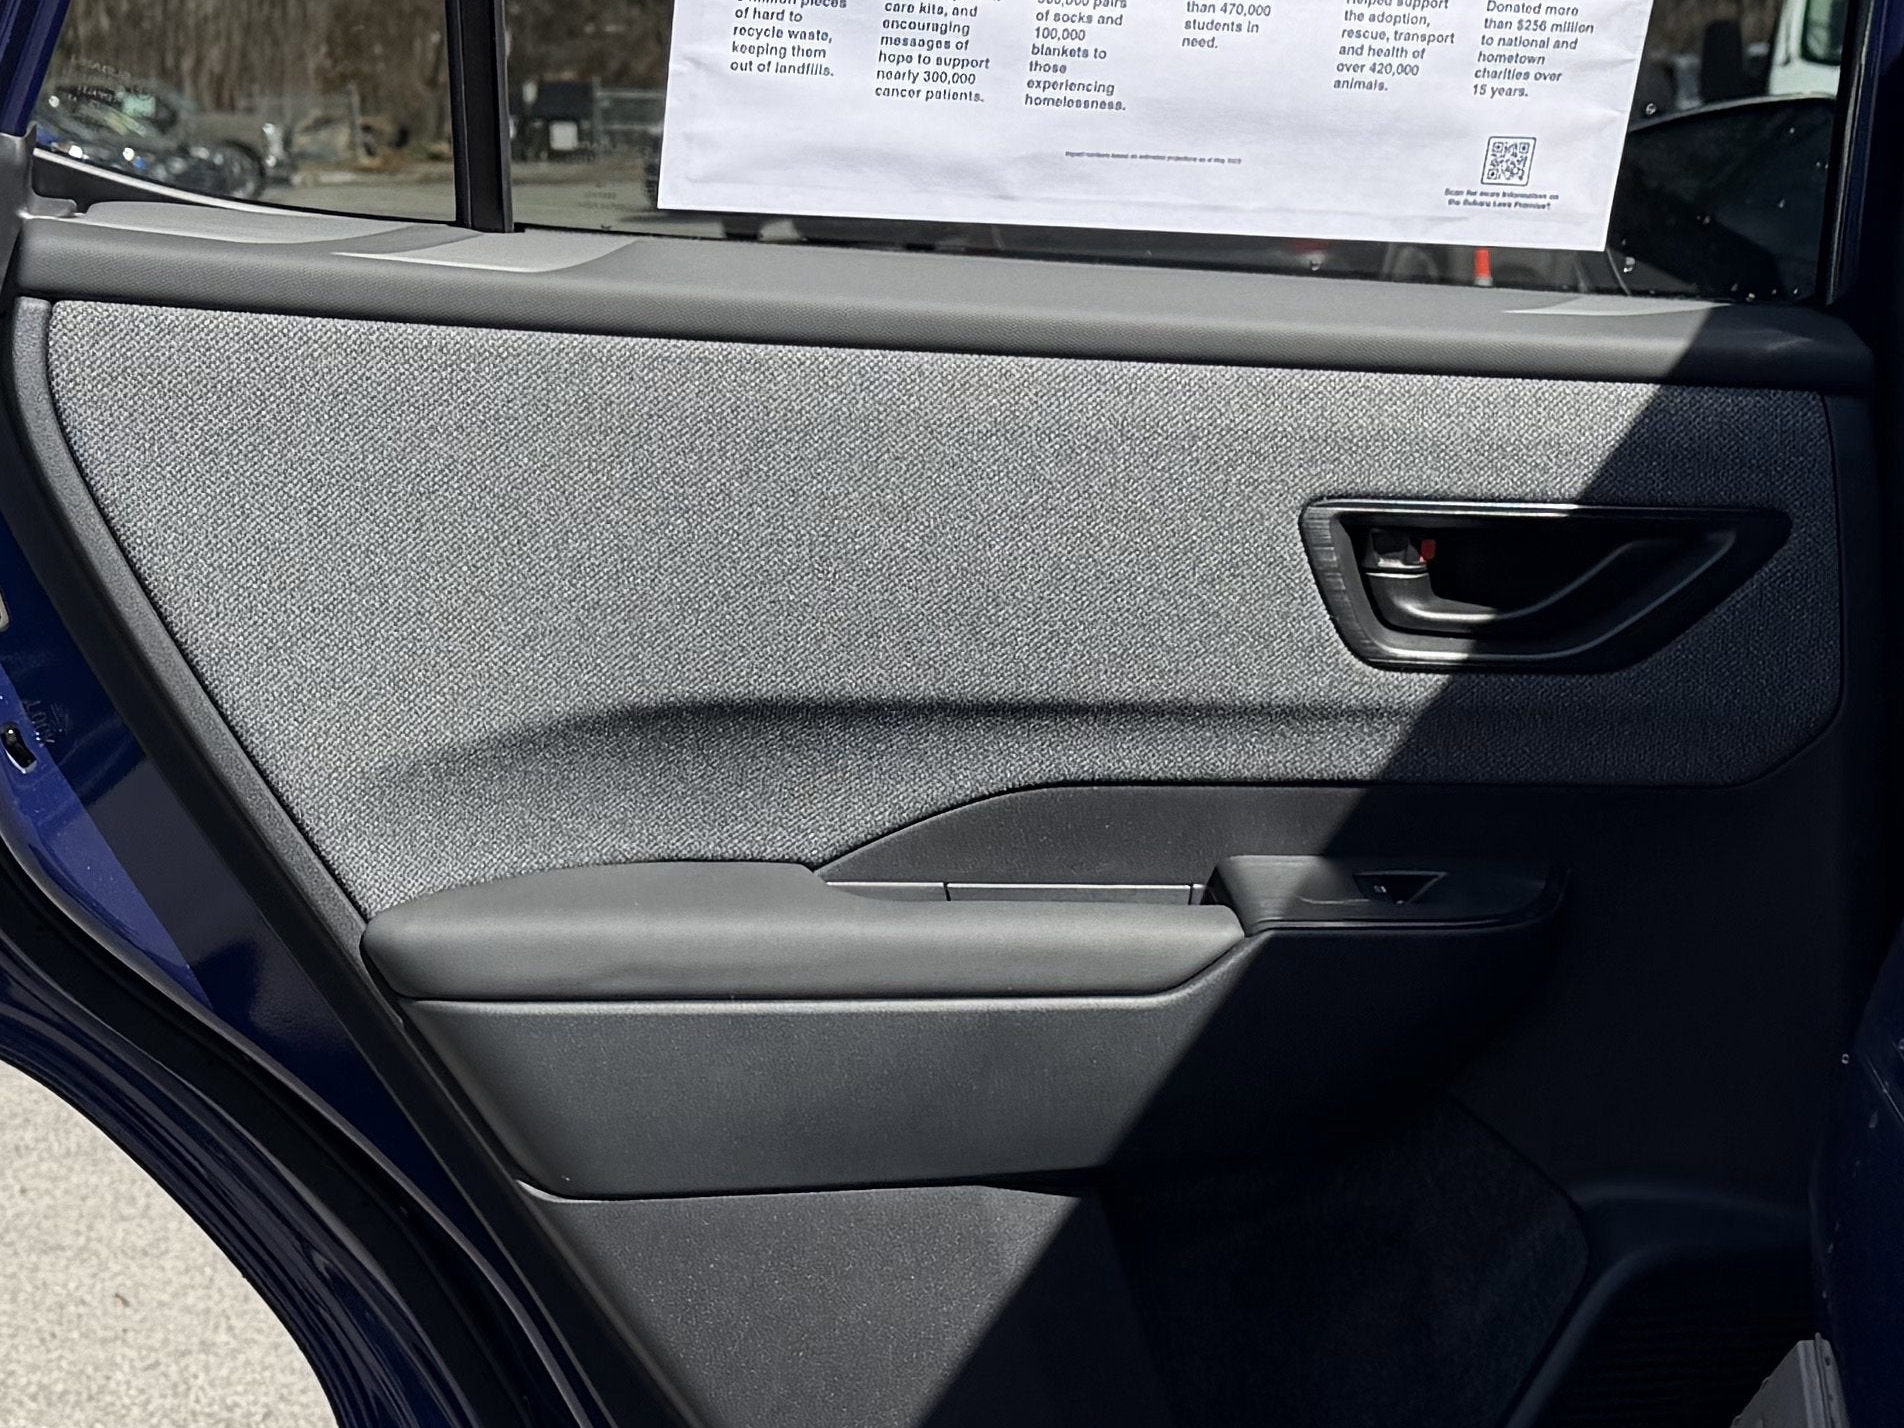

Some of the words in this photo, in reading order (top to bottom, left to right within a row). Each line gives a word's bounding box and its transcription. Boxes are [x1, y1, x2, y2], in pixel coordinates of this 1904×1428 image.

[734, 6, 750, 20] of
[752, 6, 786, 22] hard
[788, 10, 804, 23] to
[884, 2, 915, 14] care
[918, 1, 949, 18] kits,
[951, 5, 978, 18] and
[1186, 0, 1216, 14] than
[1219, 2, 1272, 18] 470,000
[1486, 0, 1543, 15] Donated
[1544, 5, 1579, 17] more
[1035, 8, 1051, 22] of
[1052, 11, 1094, 25] socks
[1097, 13, 1124, 27] and
[1184, 18, 1243, 33] students
[1246, 20, 1260, 34] in
[1344, 8, 1365, 22] the
[1367, 11, 1431, 29] adoption,
[1483, 17, 1513, 30] than
[1516, 18, 1548, 32] $256
[1549, 20, 1595, 35] million
[732, 25, 784, 41] recycle
[787, 29, 833, 44] waste,
[882, 18, 971, 38] encouraging
[1035, 26, 1087, 42] 100,000
[880, 35, 951, 52] messages
[954, 39, 970, 52] of
[1181, 35, 1219, 49] need.
[1341, 28, 1390, 44] rescue,
[1393, 29, 1455, 47] transport
[1480, 34, 1495, 47] to
[1496, 35, 1551, 50] national
[1552, 37, 1579, 51] and
[731, 40, 788, 60] keeping
[791, 44, 827, 59] them
[1030, 42, 1090, 59] blankets
[1093, 47, 1108, 60] to
[1338, 43, 1365, 57] and
[1367, 44, 1409, 59] health
[1411, 47, 1427, 60] of
[1476, 50, 1546, 66] hometown
[878, 49, 914, 67] hope
[917, 52, 932, 66] to
[935, 56, 991, 70] support
[1028, 59, 1068, 75] those
[729, 60, 754, 72] out
[756, 60, 772, 73] of
[774, 61, 834, 77] landfills.
[876, 68, 920, 85] nearly
[922, 70, 977, 86] 300,000
[1336, 62, 1367, 74] over
[1368, 61, 1420, 77] 420,000
[1474, 66, 1531, 81] charities
[1533, 71, 1563, 82] over
[1026, 78, 1115, 97] experiencing
[1333, 76, 1389, 92] animals.
[1473, 83, 1488, 96] 15
[1489, 86, 1529, 100] years.
[874, 86, 922, 99] cancer
[924, 88, 985, 103] patients.
[1024, 92, 1126, 111] homelessness.
